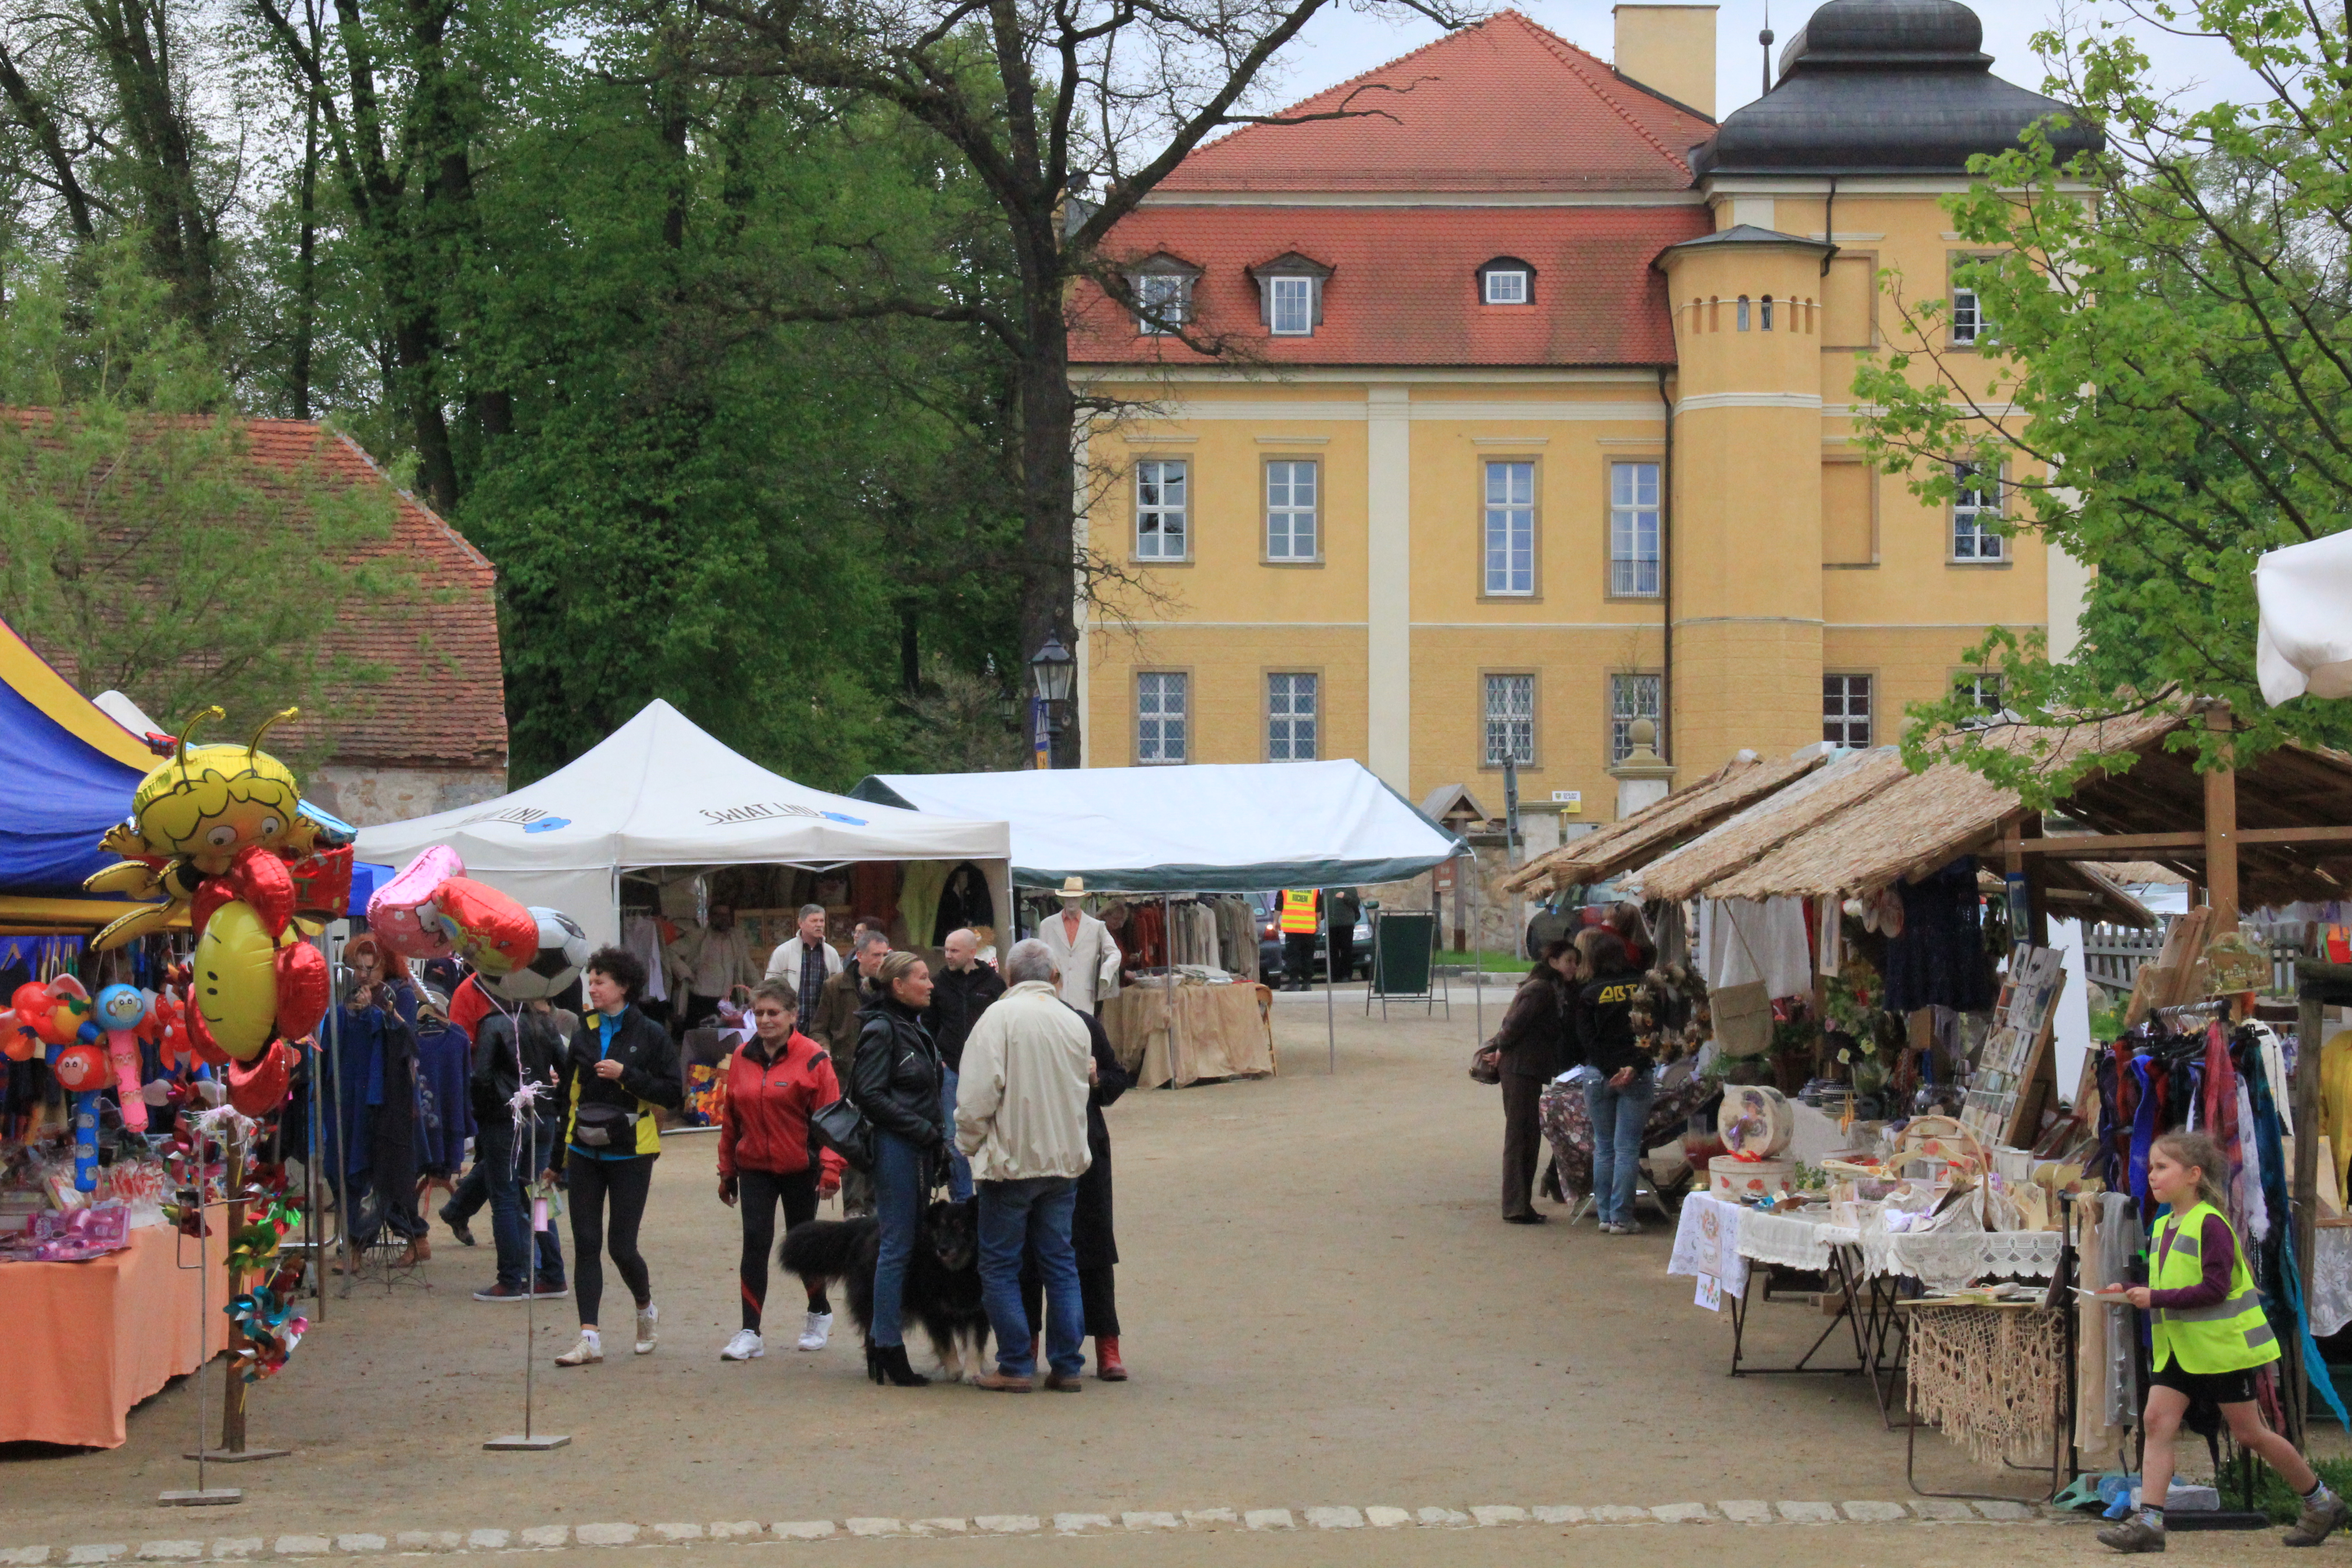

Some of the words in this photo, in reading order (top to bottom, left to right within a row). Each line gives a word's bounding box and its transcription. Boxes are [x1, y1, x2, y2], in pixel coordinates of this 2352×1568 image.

[499, 807, 548, 821] LNU
[699, 804, 773, 825] ŚWIAT
[773, 803, 819, 816] LNU
